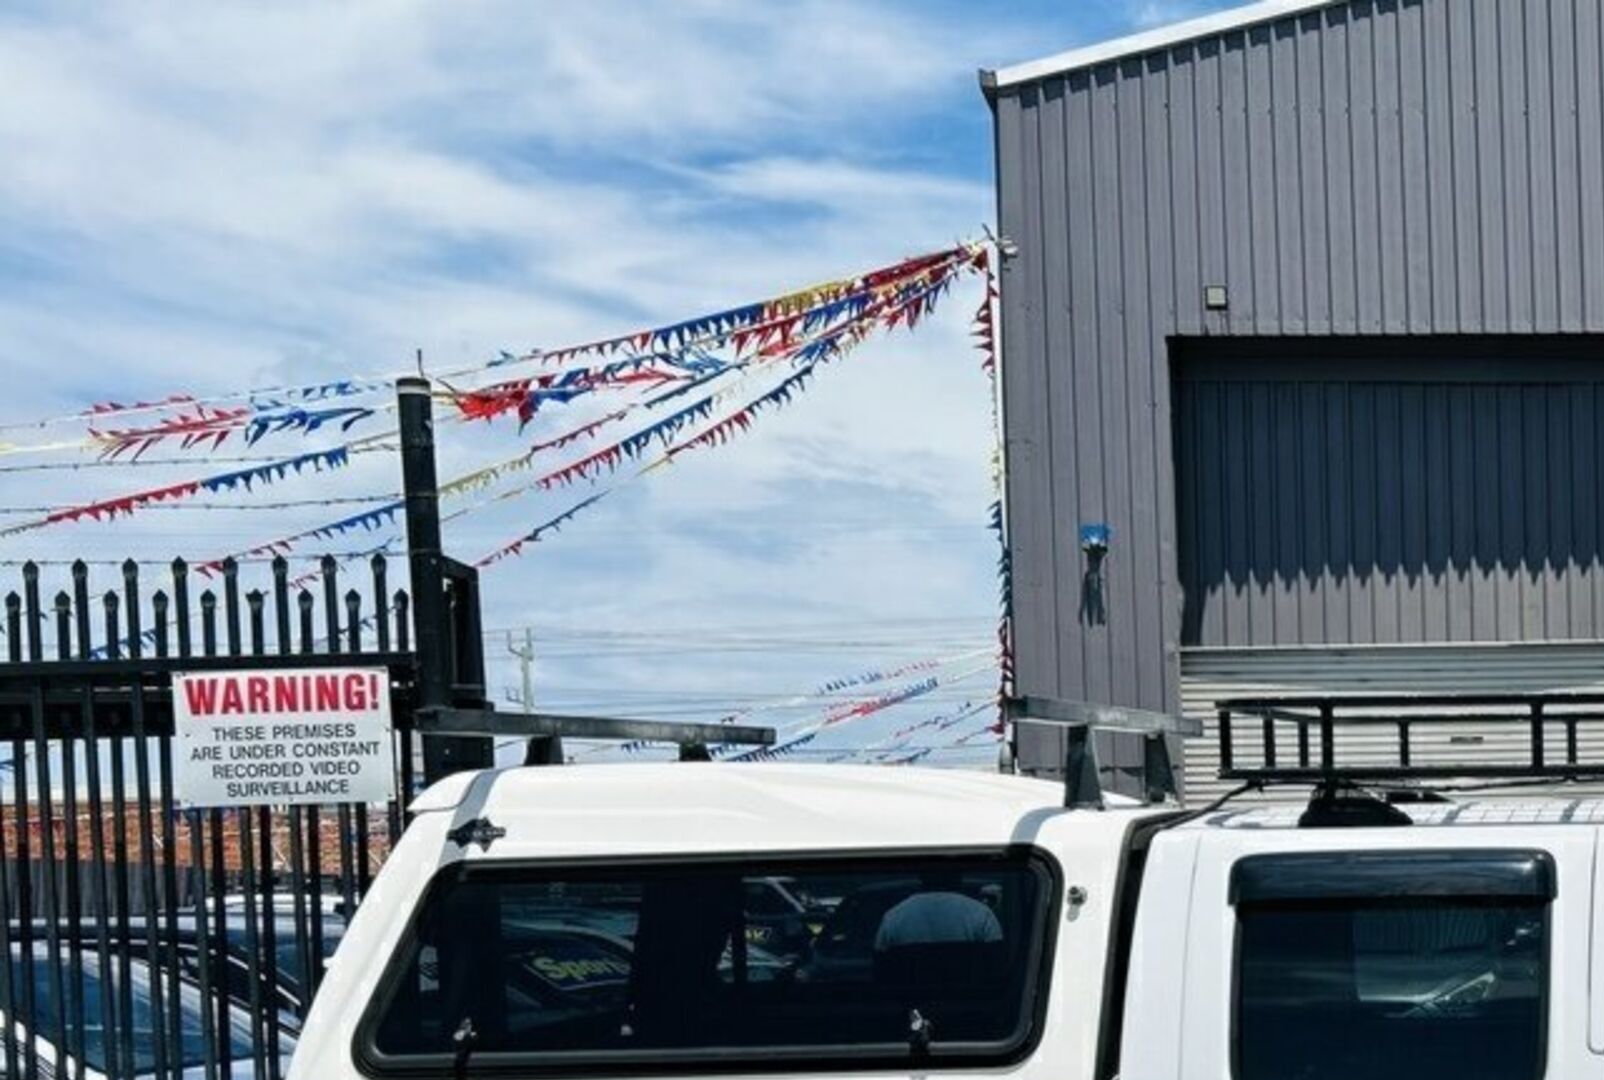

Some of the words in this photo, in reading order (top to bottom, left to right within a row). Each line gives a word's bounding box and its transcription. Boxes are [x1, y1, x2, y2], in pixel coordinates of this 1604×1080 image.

[184, 674, 380, 717] WARNING!
[212, 726, 266, 741] THESE
[272, 723, 357, 739] PREMISES
[190, 747, 223, 761] ARE
[229, 744, 287, 760] UNDER
[292, 741, 381, 757] CONSTANT
[212, 763, 304, 779] RECORDED
[310, 761, 361, 776] VIDEO
[227, 779, 350, 798] SURVEILLANCE
